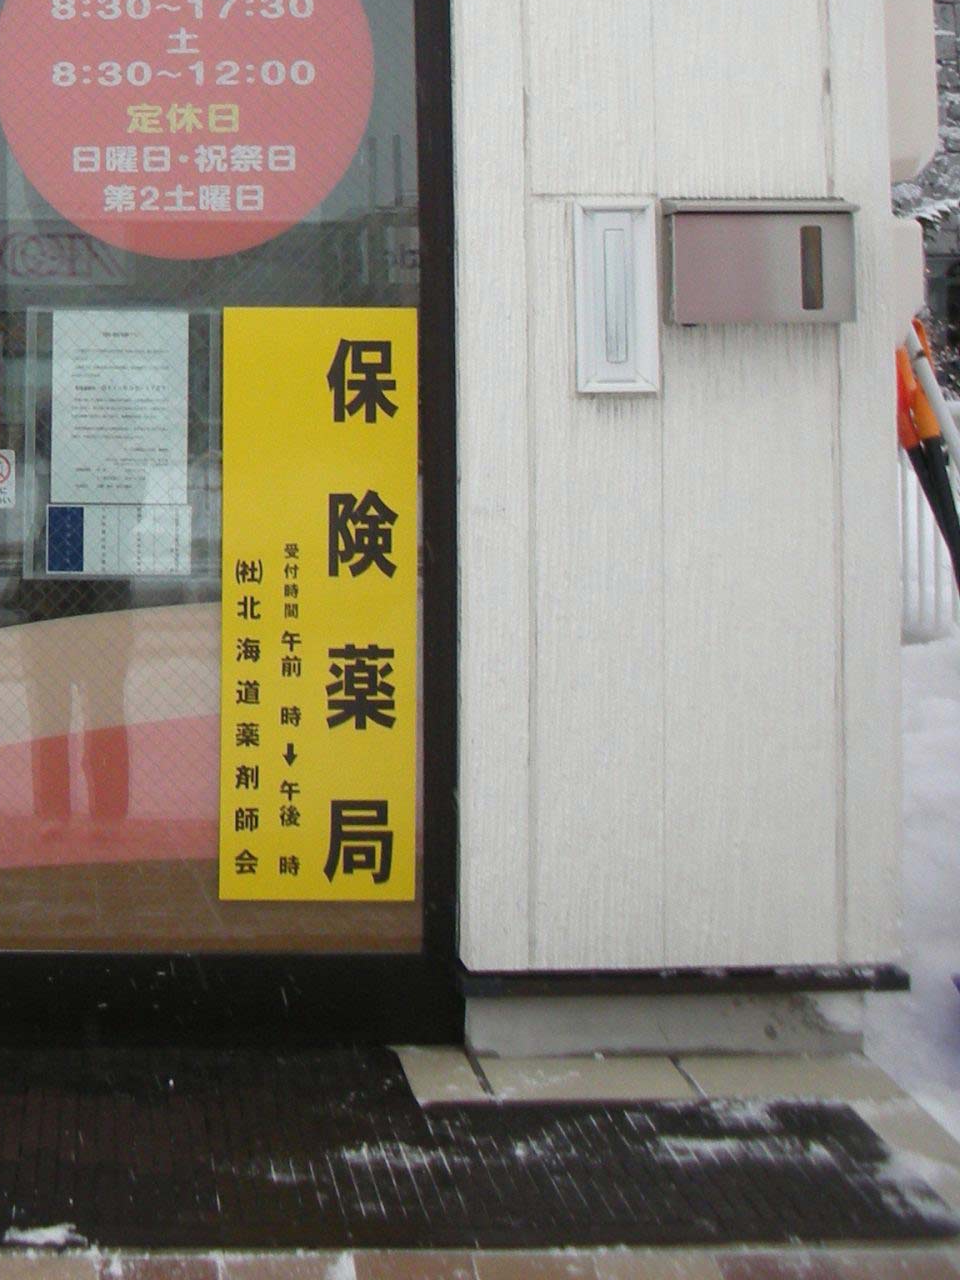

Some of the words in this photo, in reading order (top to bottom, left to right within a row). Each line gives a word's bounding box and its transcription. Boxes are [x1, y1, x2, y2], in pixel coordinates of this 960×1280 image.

[167, 28, 200, 55] 土
[127, 103, 241, 135] 定休日
[103, 185, 265, 213] 第2土曜日
[284, 543, 299, 619] 受付時間
[322, 338, 399, 885] 保険薬局
[280, 631, 302, 677] 午前
[280, 706, 302, 727] 時
[279, 780, 301, 828] 午後
[278, 855, 300, 877] 時
